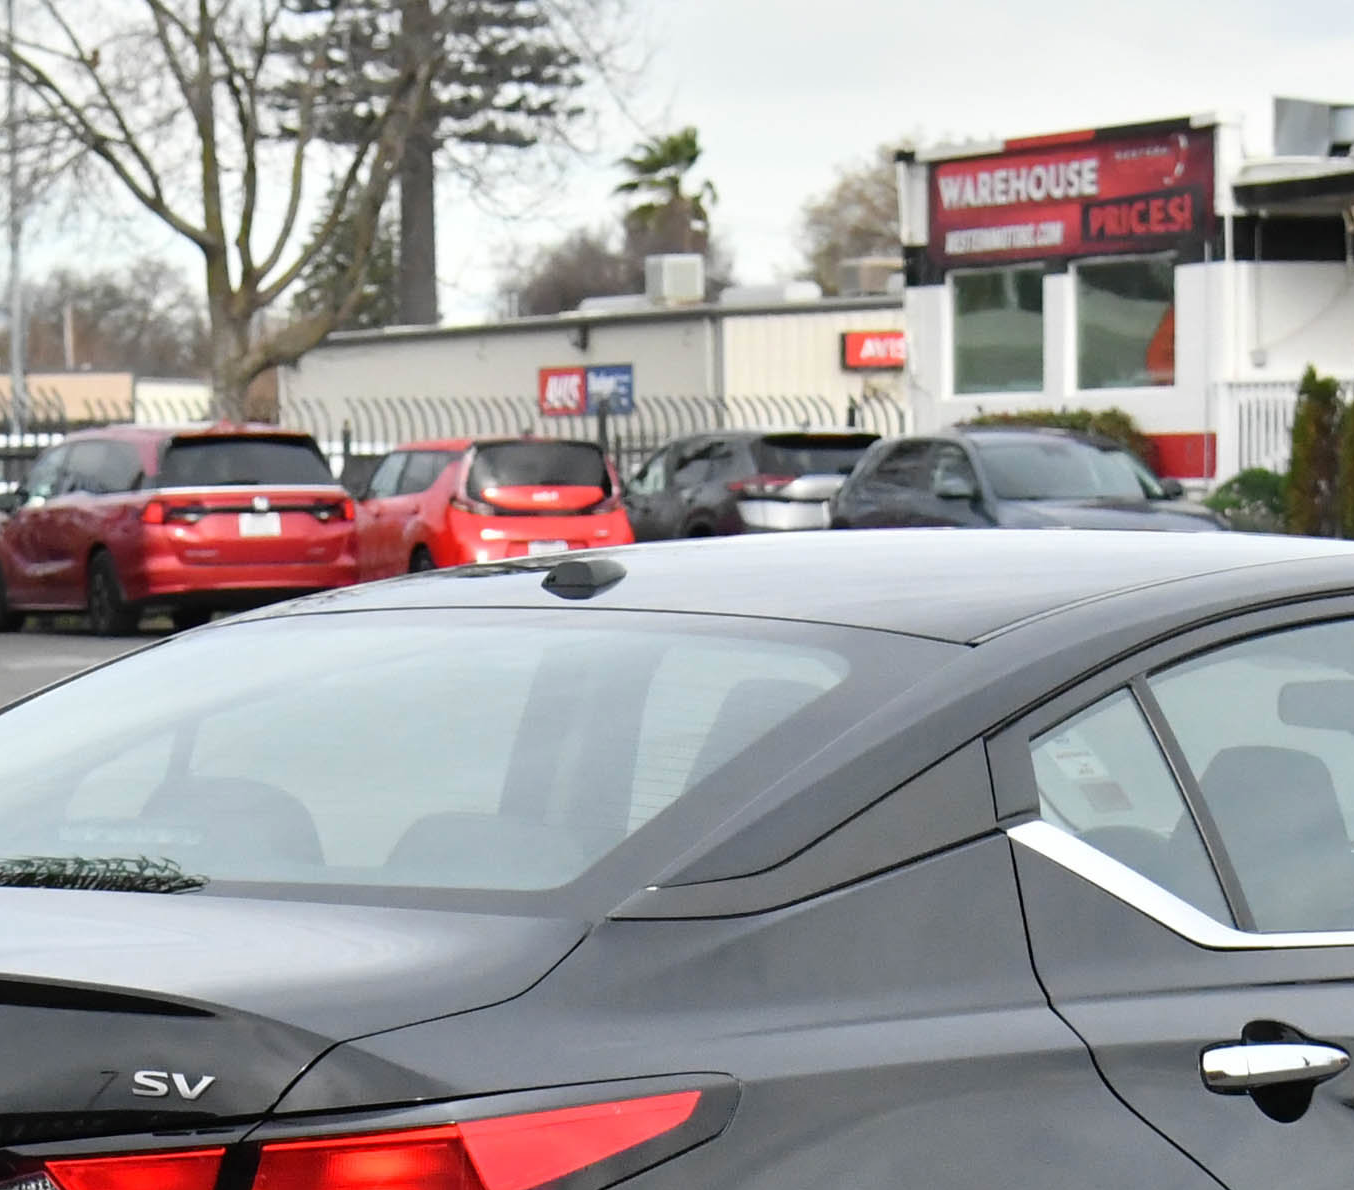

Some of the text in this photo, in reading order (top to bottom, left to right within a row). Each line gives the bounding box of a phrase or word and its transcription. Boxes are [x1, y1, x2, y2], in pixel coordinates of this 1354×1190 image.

[938, 157, 1099, 210] WAREHOUSE
[1089, 193, 1193, 237] PRICES!
[132, 1070, 216, 1100] SV
